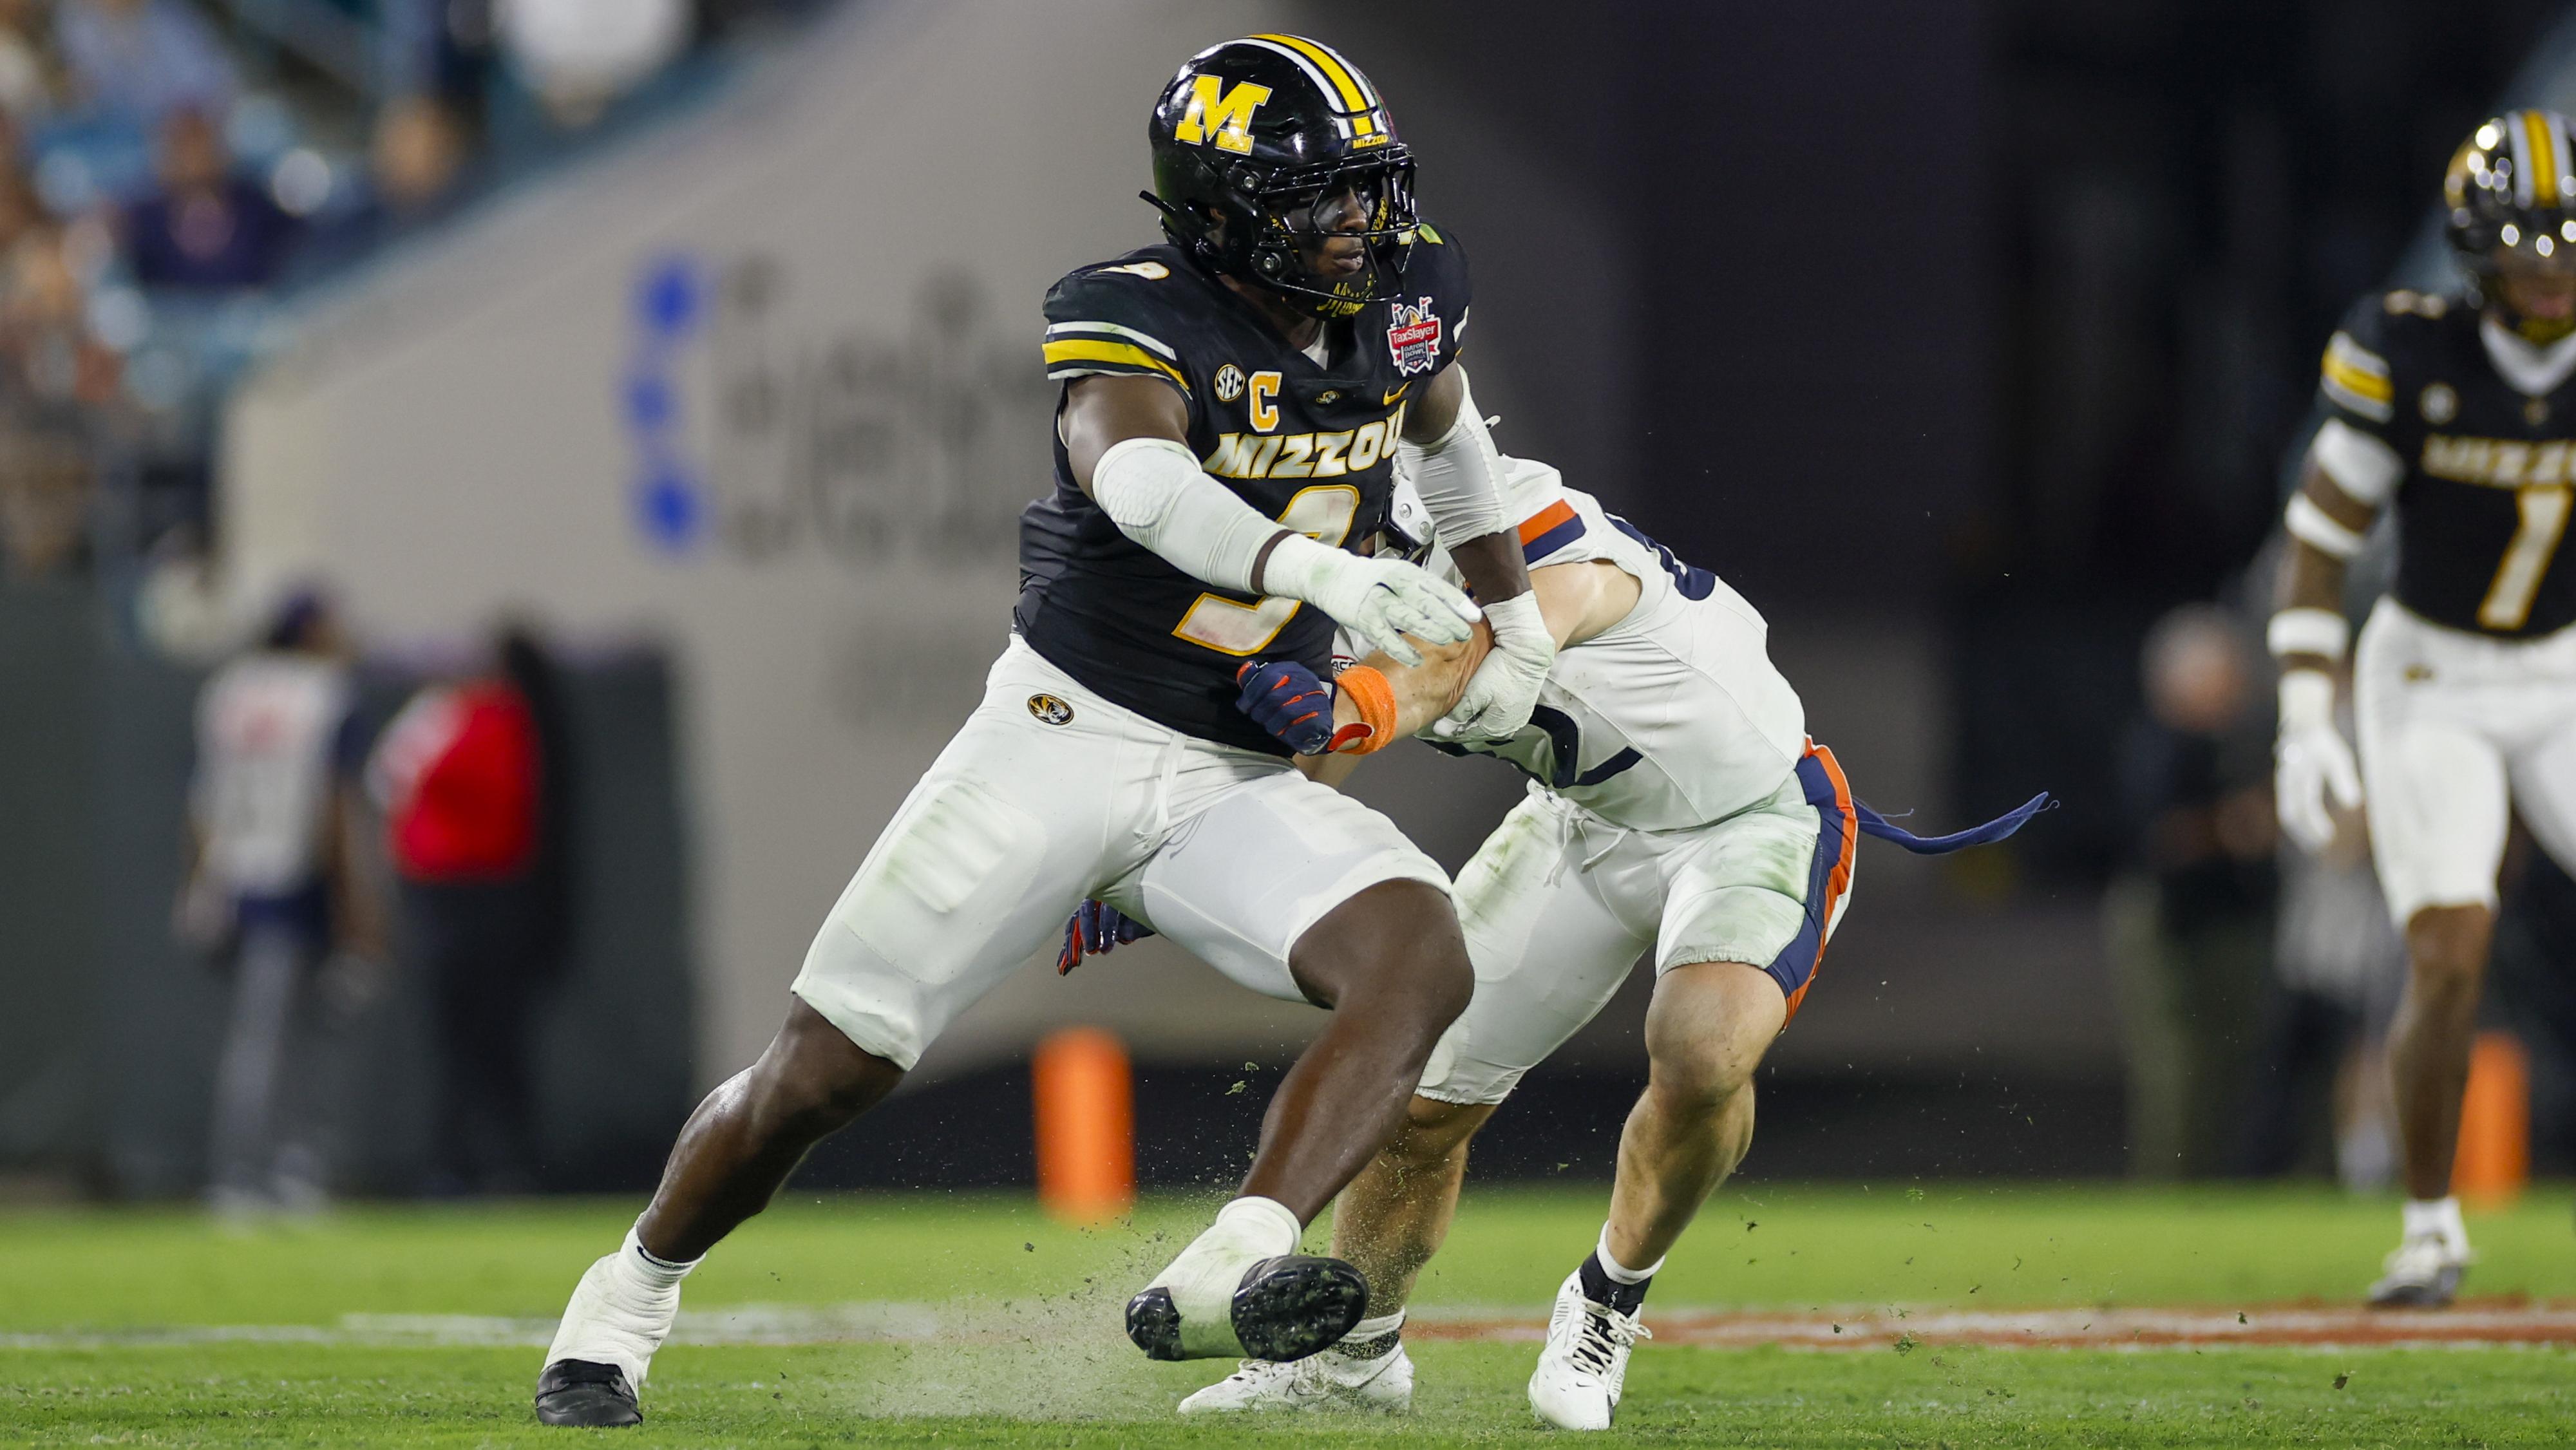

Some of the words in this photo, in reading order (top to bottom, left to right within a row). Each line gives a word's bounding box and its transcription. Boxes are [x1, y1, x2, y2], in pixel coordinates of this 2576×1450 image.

[1175, 74, 1273, 156] M
[1352, 134, 1388, 149] MIZZOU
[1392, 325, 1436, 344] TaxSlayer
[1404, 343, 1425, 352] GATOR
[1405, 348, 1426, 359] BOWL
[1217, 366, 1244, 400] SEC
[1249, 371, 1282, 432] C
[1202, 399, 1407, 479] MIZZOU
[2477, 483, 2575, 631] 7
